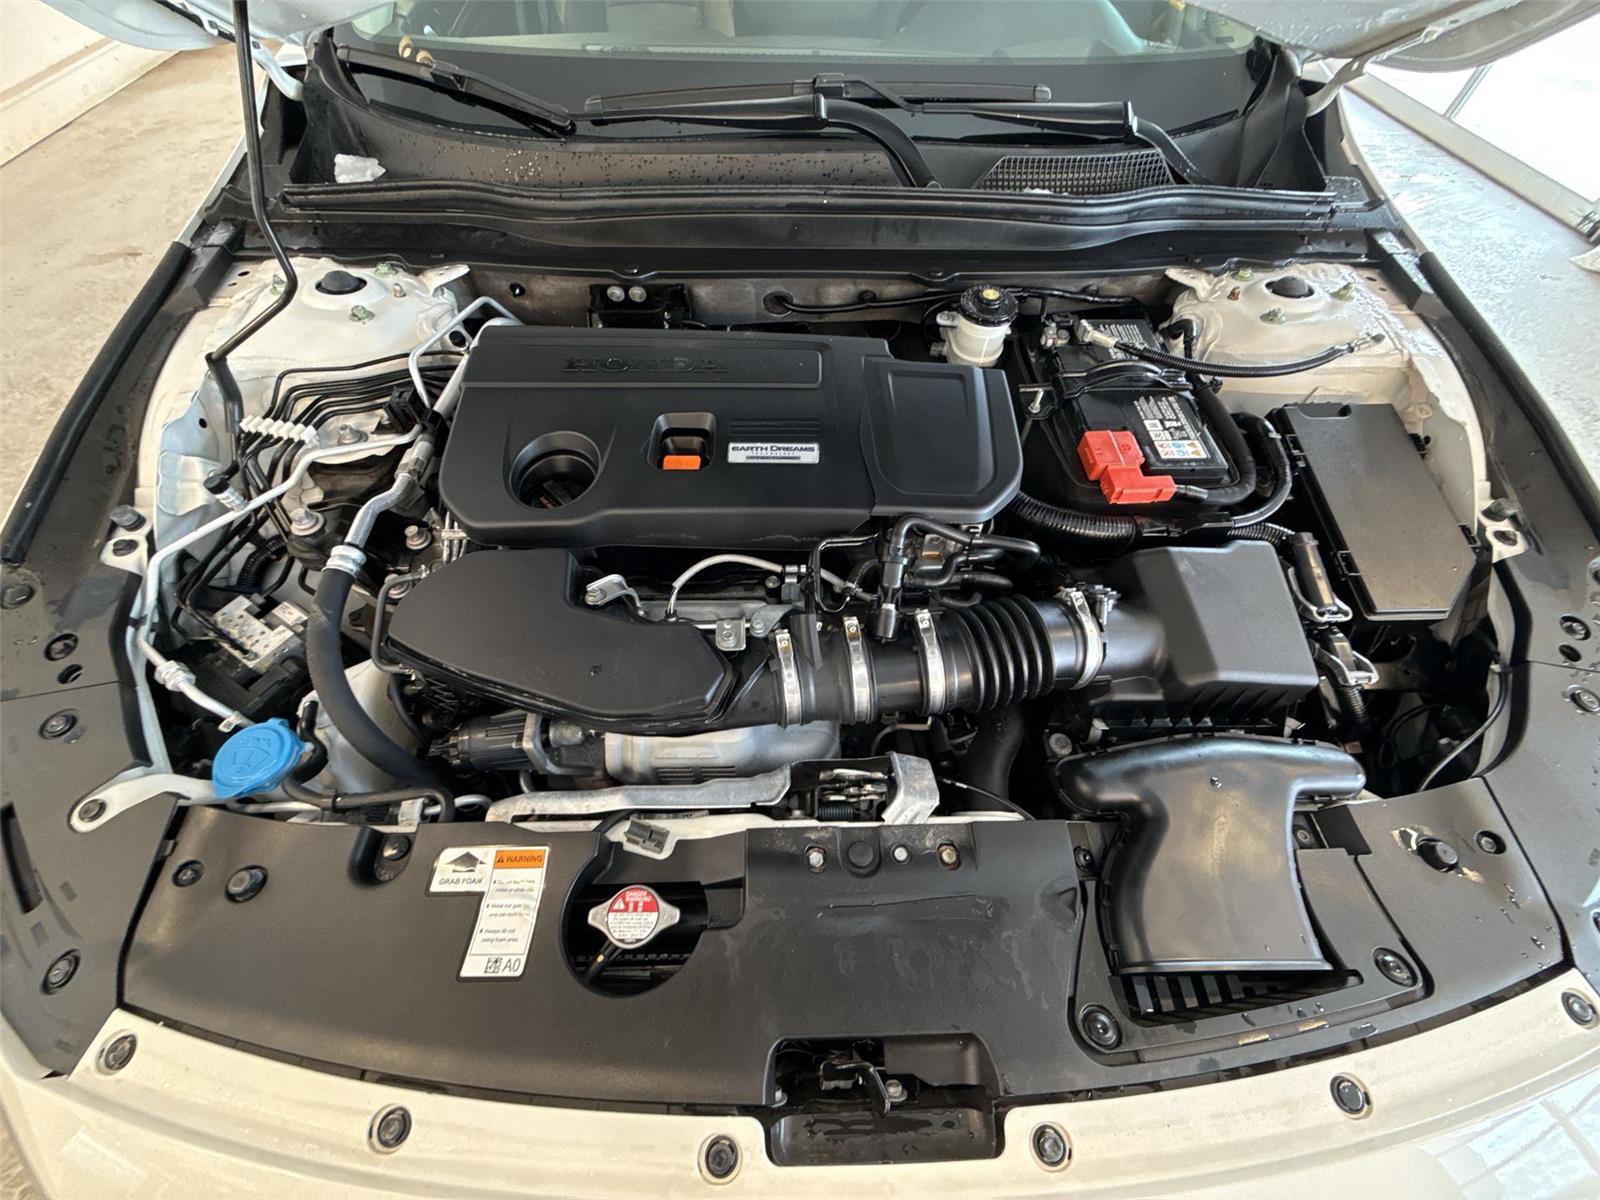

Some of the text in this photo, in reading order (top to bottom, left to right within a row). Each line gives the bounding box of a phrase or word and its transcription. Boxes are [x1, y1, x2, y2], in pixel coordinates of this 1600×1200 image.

[563, 357, 730, 373] HONDA
[506, 854, 543, 863] WARNING
[461, 877, 483, 885] FOAM
[501, 957, 521, 973] A0
